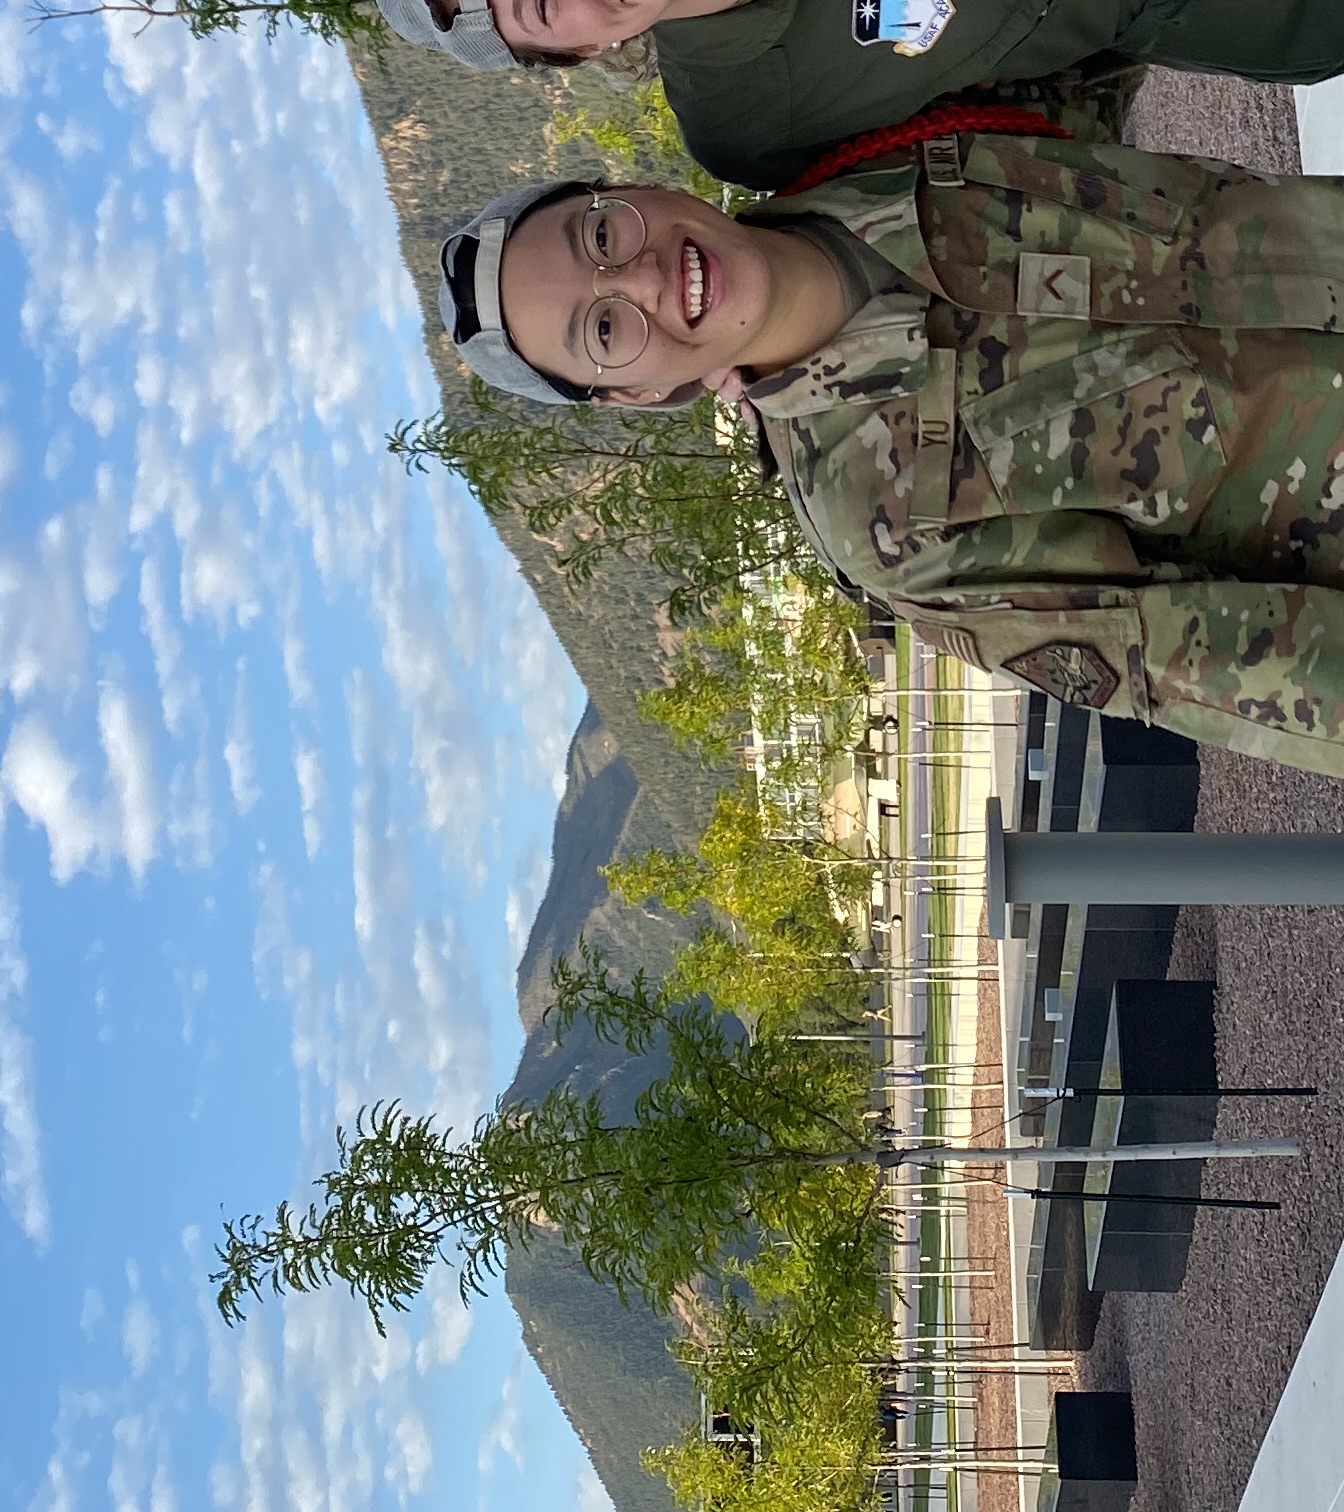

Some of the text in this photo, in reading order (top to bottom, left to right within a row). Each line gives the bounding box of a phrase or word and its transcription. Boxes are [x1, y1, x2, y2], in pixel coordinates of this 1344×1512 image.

[917, 23, 939, 47] USAF
[928, 146, 957, 165] AIR
[921, 419, 950, 448] YU
